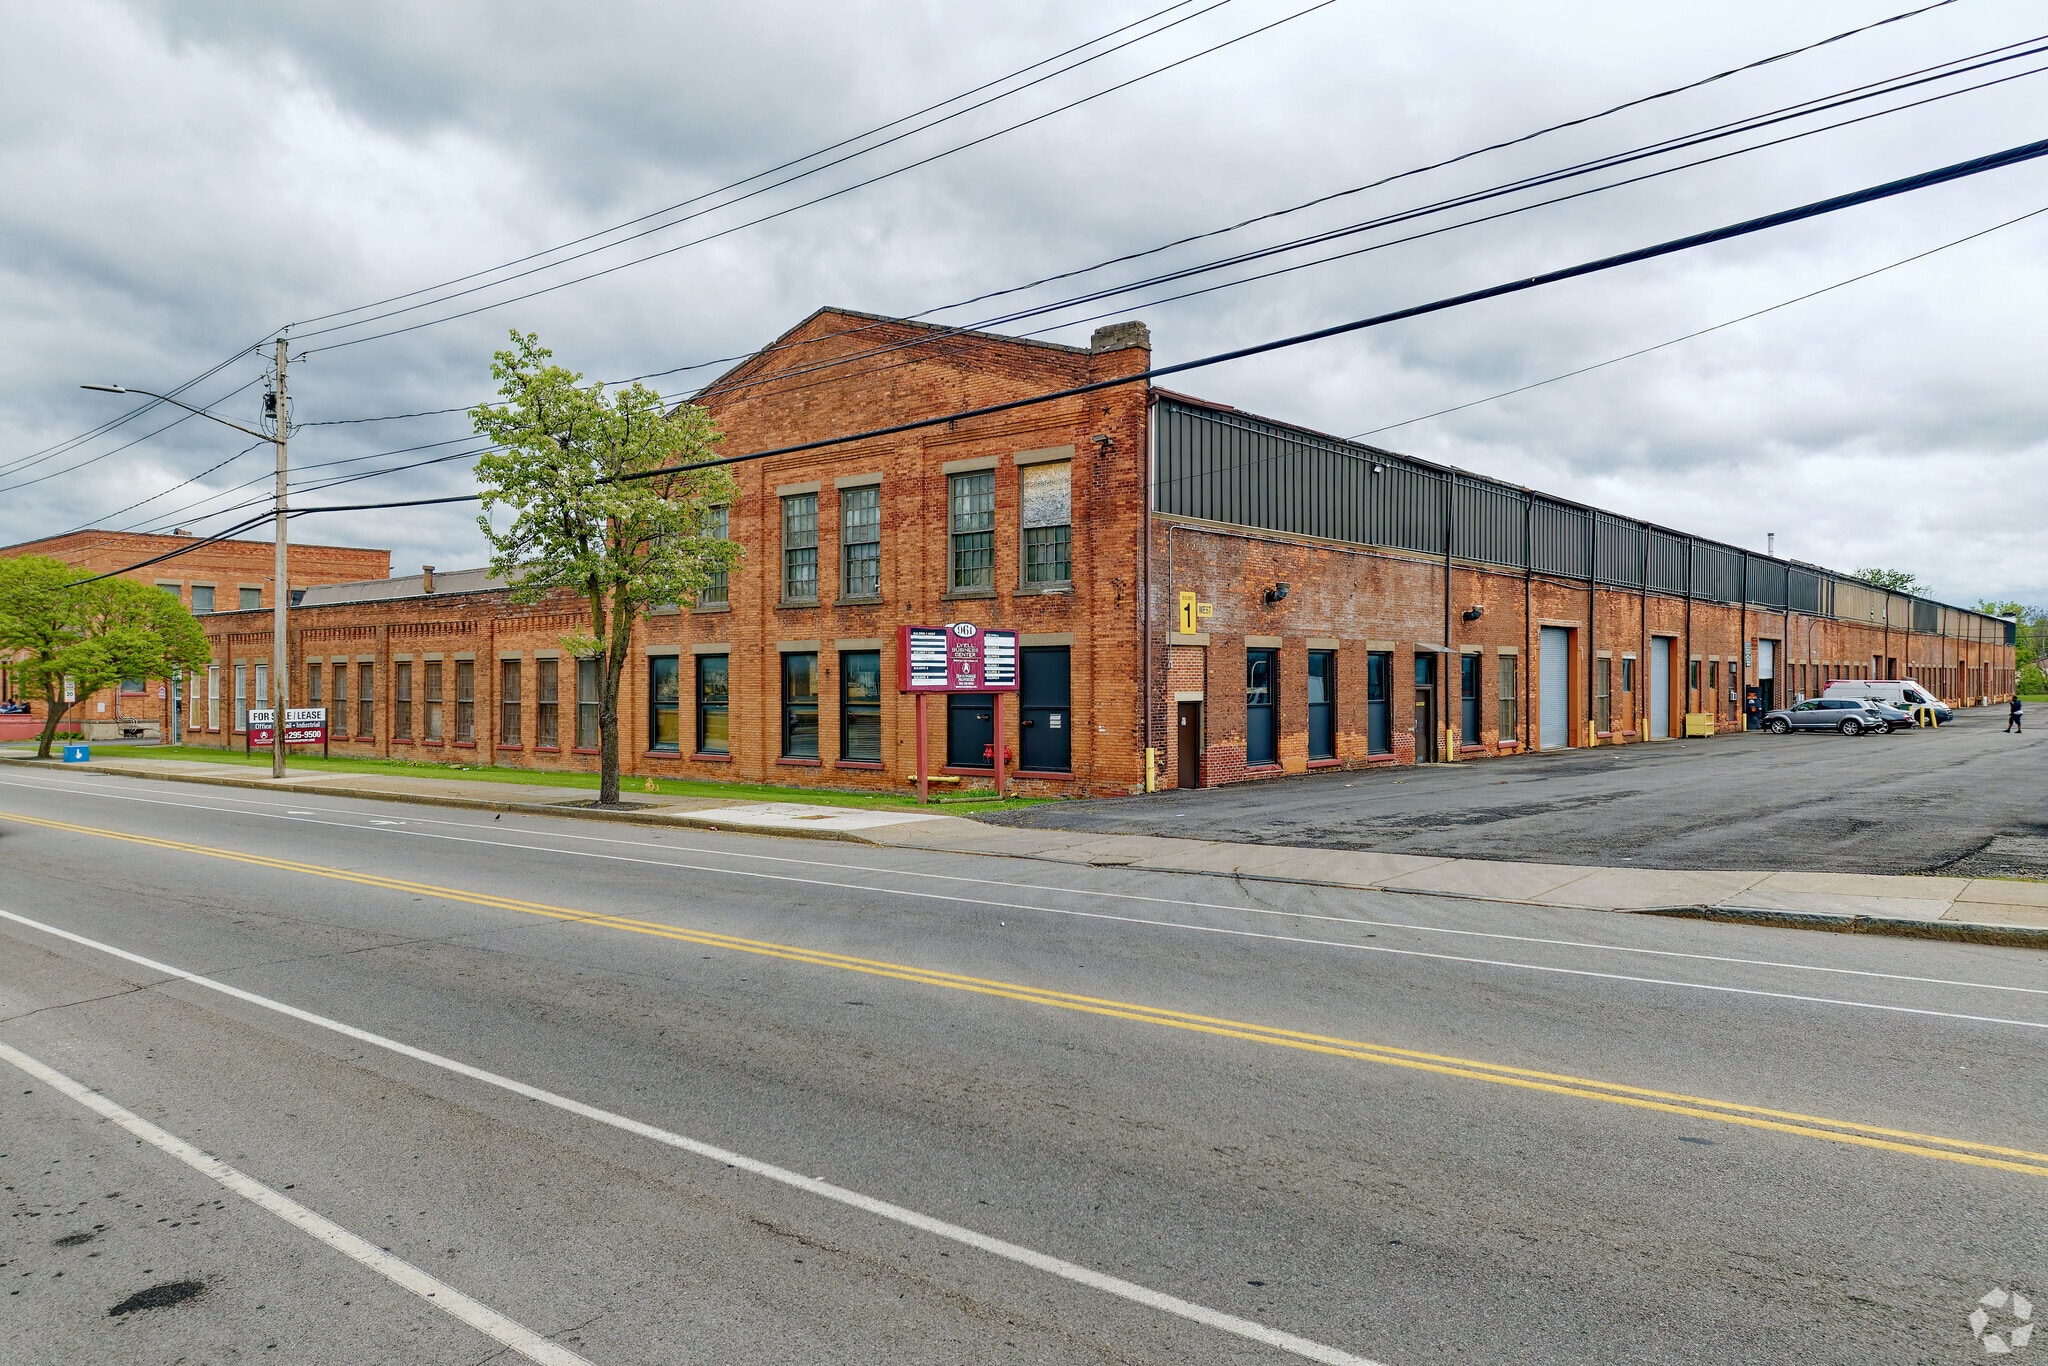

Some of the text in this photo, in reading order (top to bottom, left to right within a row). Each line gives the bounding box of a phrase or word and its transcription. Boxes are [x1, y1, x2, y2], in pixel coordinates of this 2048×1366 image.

[1199, 605, 1211, 614] WEST
[1184, 603, 1190, 628] 1
[957, 625, 973, 635] 961
[253, 712, 269, 721] FOR
[297, 711, 321, 719] LEASE
[288, 731, 321, 739] 295-9500
